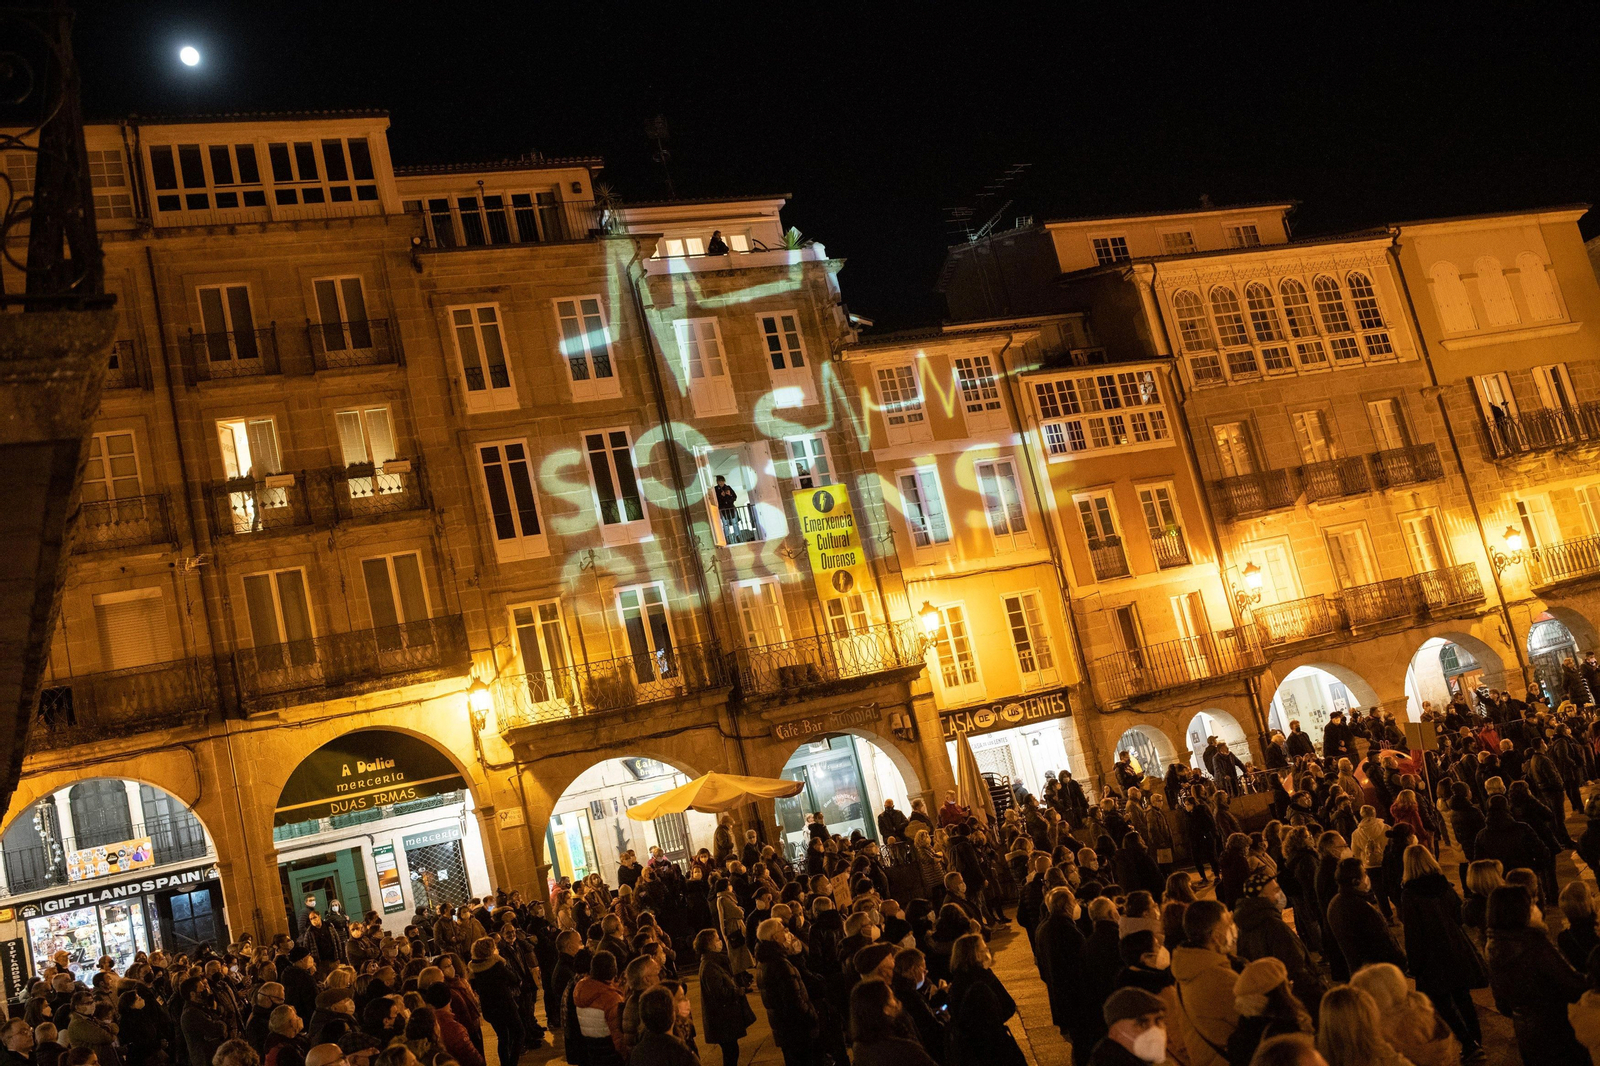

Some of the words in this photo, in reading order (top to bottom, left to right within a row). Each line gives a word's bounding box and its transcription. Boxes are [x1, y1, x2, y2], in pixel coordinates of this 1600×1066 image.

[803, 511, 853, 533] Emerxencia
[816, 531, 850, 551] Cultural
[820, 552, 856, 570] Ourense
[775, 722, 799, 740] Café
[802, 719, 823, 733] Bar
[829, 707, 879, 728] MUNDIAL
[940, 711, 976, 737] CASA
[978, 713, 991, 723] DE
[1006, 707, 1020, 717] LOS
[1023, 692, 1066, 720] LENTES
[341, 764, 352, 778] A
[356, 757, 396, 774] Dalia
[330, 797, 367, 814] DUAS
[372, 787, 417, 805] IRMAS
[43, 870, 201, 912] GIFTLANDSPAIN
[7, 941, 22, 997] GIFTLANDSPAIN
